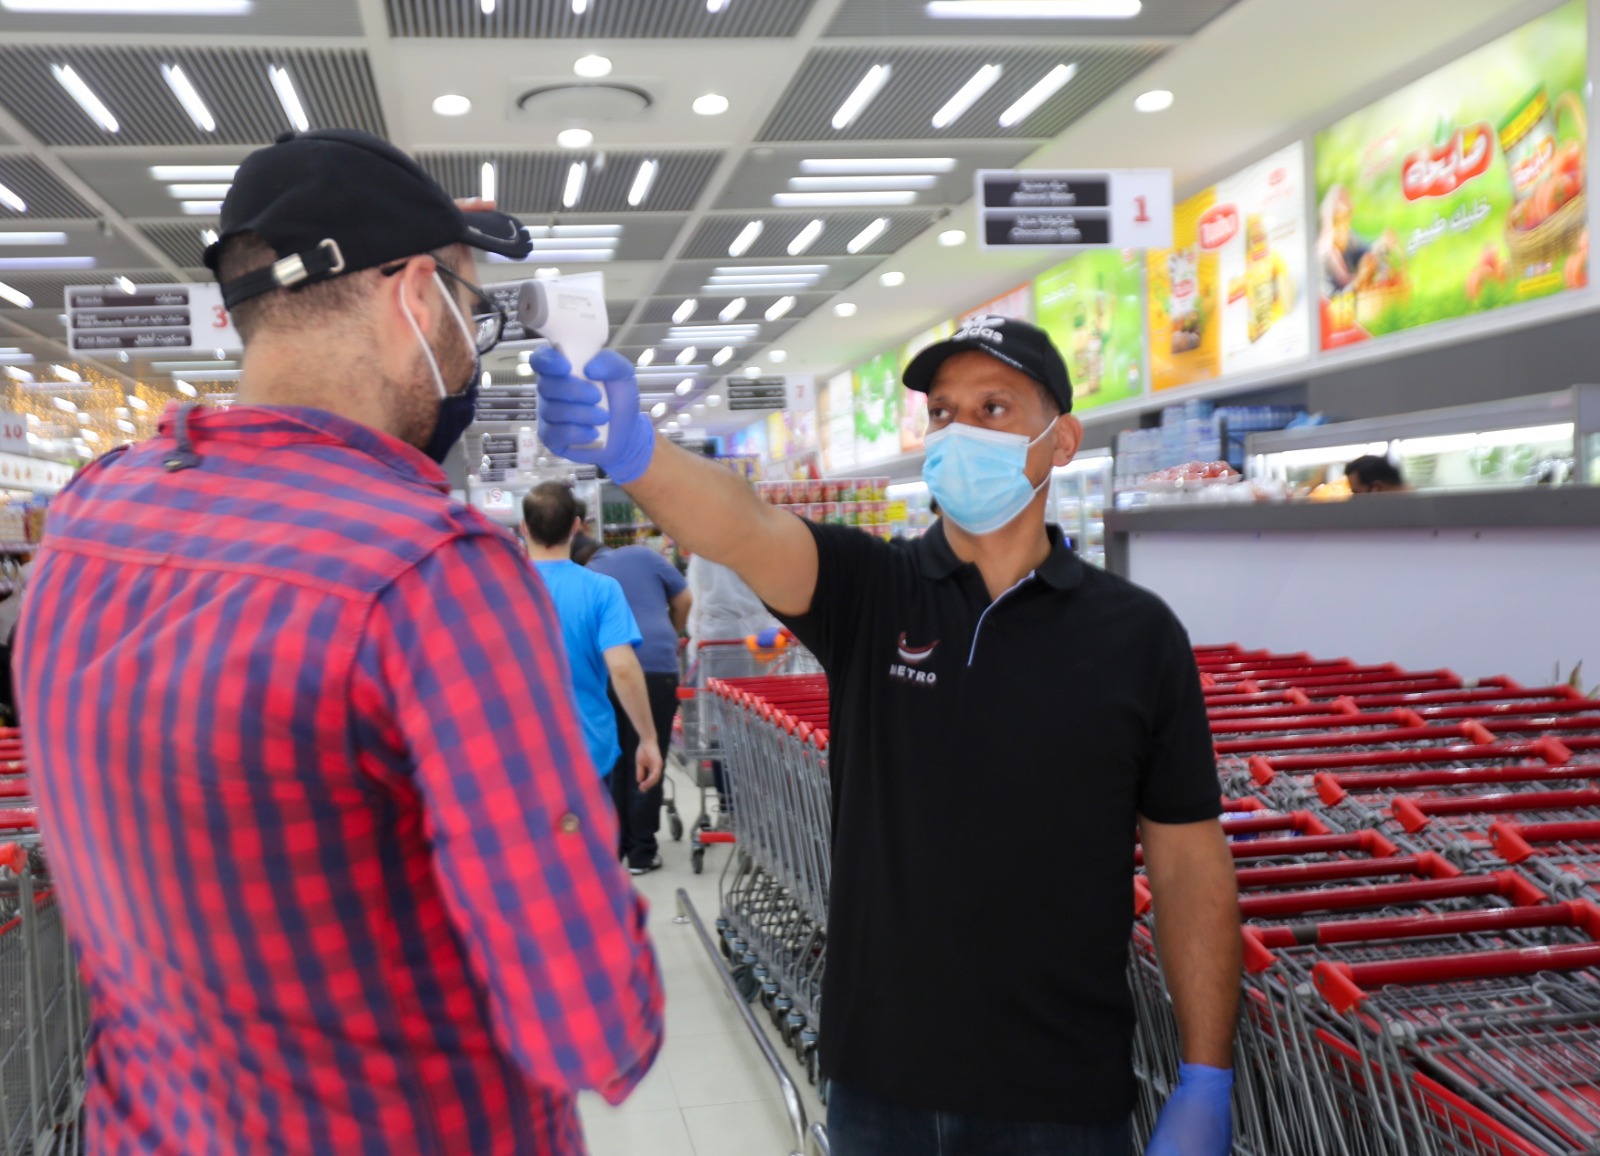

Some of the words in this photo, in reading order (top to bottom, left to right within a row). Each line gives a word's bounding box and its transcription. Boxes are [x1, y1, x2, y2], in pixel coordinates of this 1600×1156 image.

[1133, 196, 1150, 222] 1
[212, 304, 228, 328] 3
[3, 424, 23, 438] 10
[889, 663, 937, 684] METRO
